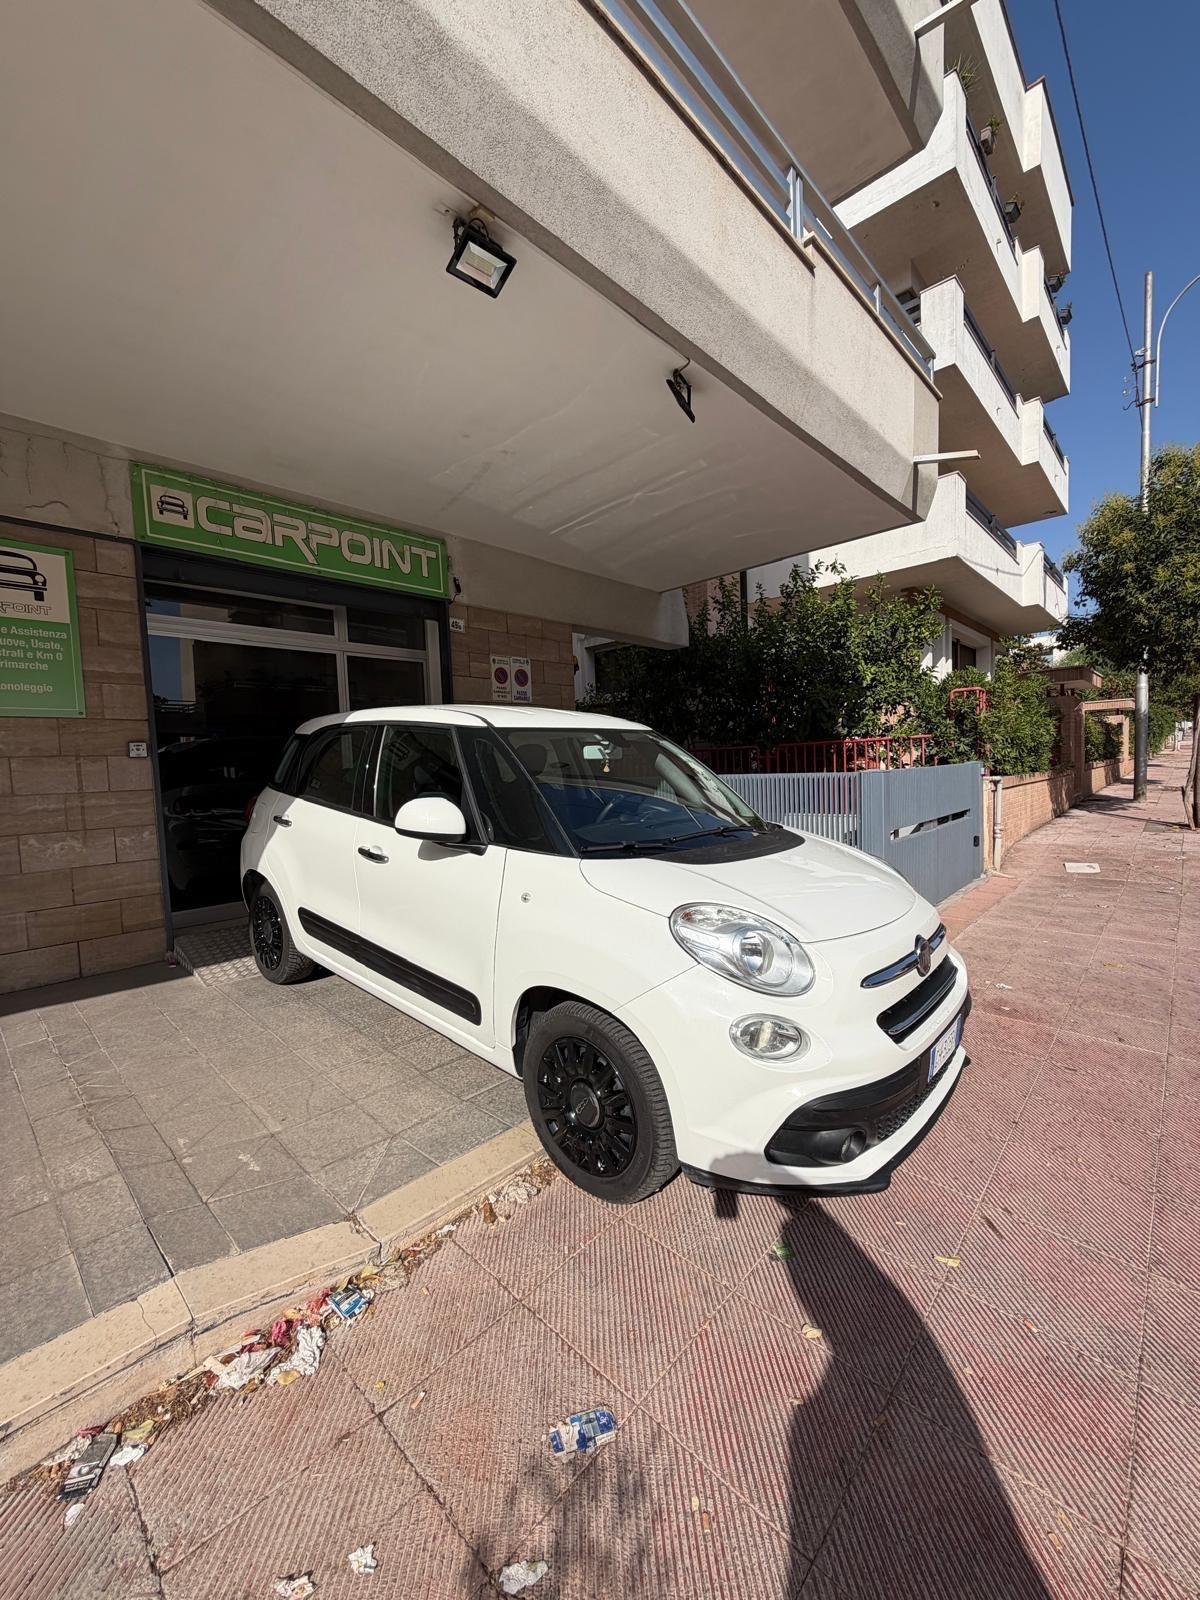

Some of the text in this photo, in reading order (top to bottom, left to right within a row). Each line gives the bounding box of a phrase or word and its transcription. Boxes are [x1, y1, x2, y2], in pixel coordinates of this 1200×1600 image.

[1, 626, 67, 639] e Assistenza
[31, 639, 63, 651] Usato,
[0, 648, 24, 658] trali
[27, 651, 33, 659] e
[36, 651, 53, 660] Km
[0, 660, 48, 671] rimarche
